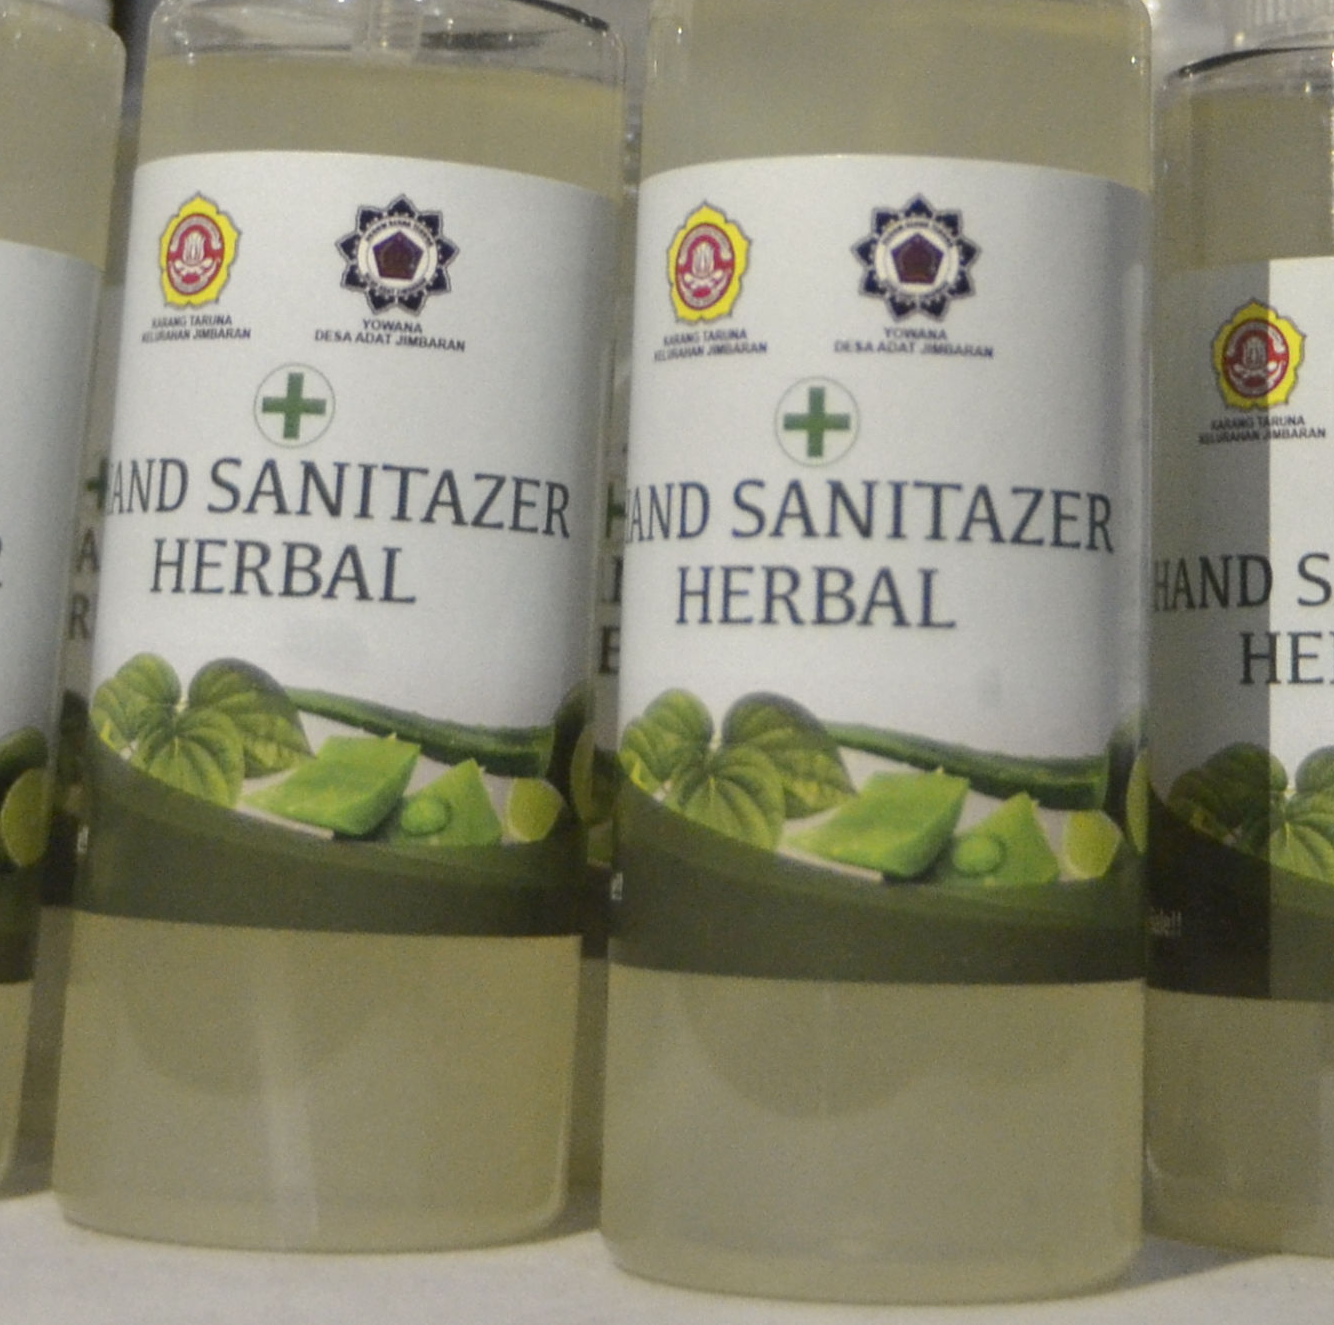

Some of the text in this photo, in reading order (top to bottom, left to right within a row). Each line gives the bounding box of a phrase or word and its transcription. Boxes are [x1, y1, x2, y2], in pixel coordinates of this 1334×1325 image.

[193, 327, 252, 340] JIMBARAN
[362, 318, 423, 334] YOWANA
[884, 327, 948, 341] YOWANA
[314, 329, 465, 352] DESA ADAT JIMBARAN
[707, 342, 768, 357] JIMBARAN
[834, 340, 994, 360] DESA ADAT JIMBARAN
[1257, 414, 1306, 427] TARUNA
[207, 456, 571, 540] SANITAZER
[731, 478, 1115, 554] SANITAZER
[150, 537, 417, 605] HERBAL
[1152, 553, 1273, 613] HAND
[675, 565, 957, 631] HERBAL
